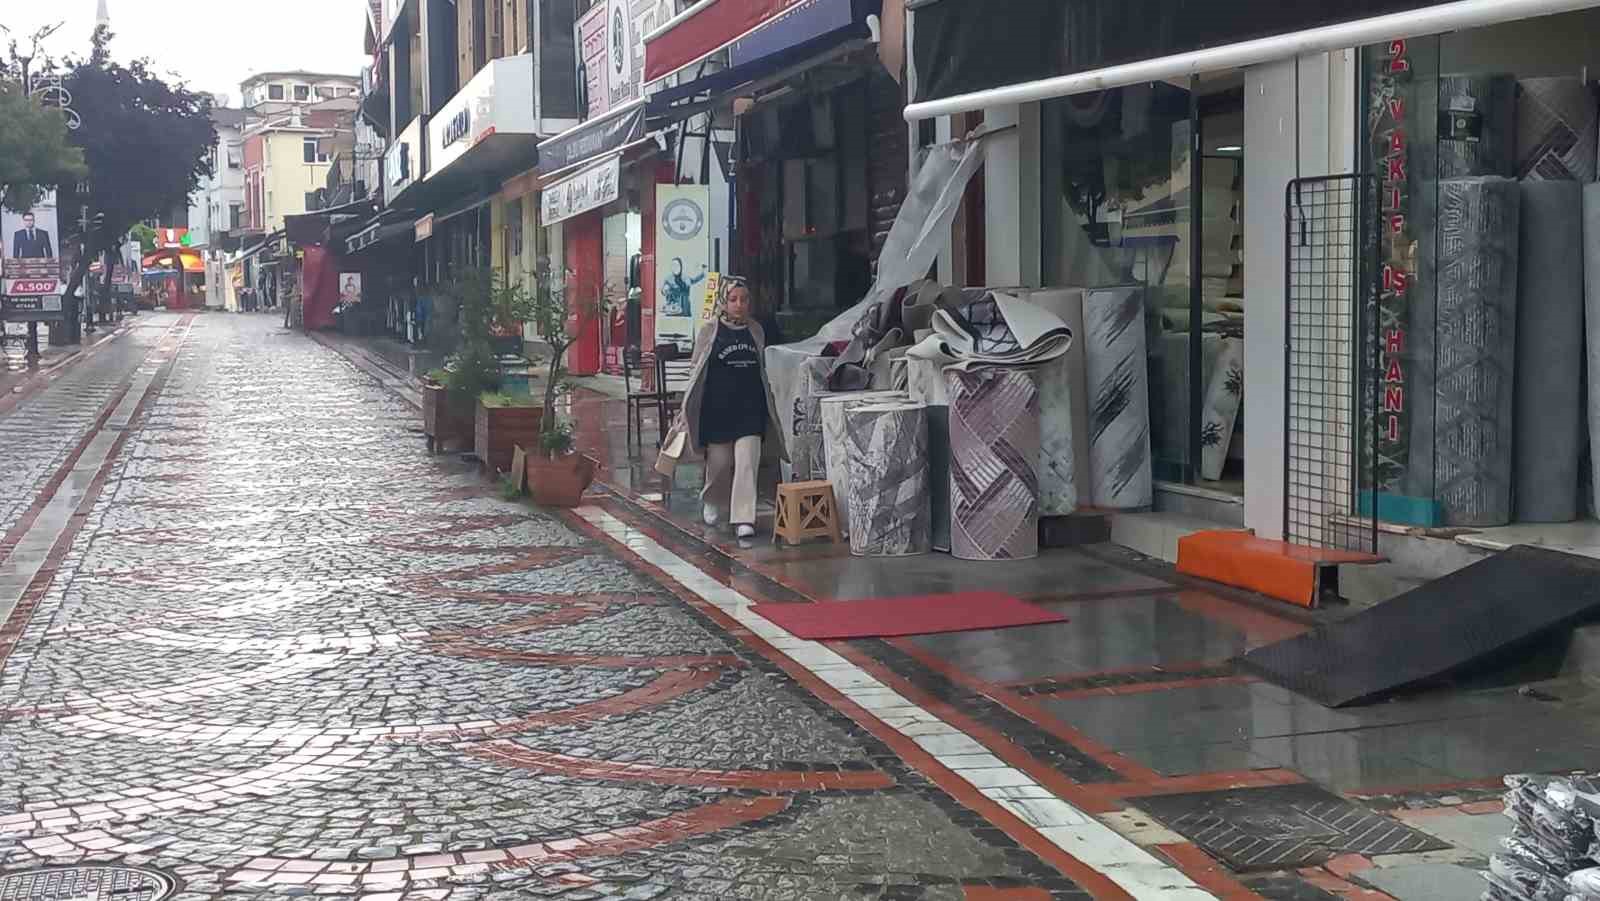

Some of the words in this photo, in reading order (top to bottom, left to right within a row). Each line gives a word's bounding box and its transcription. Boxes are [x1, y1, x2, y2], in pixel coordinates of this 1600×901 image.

[1388, 38, 1409, 72] 2
[1387, 98, 1408, 235] VAKIF
[1384, 328, 1405, 442] HANI
